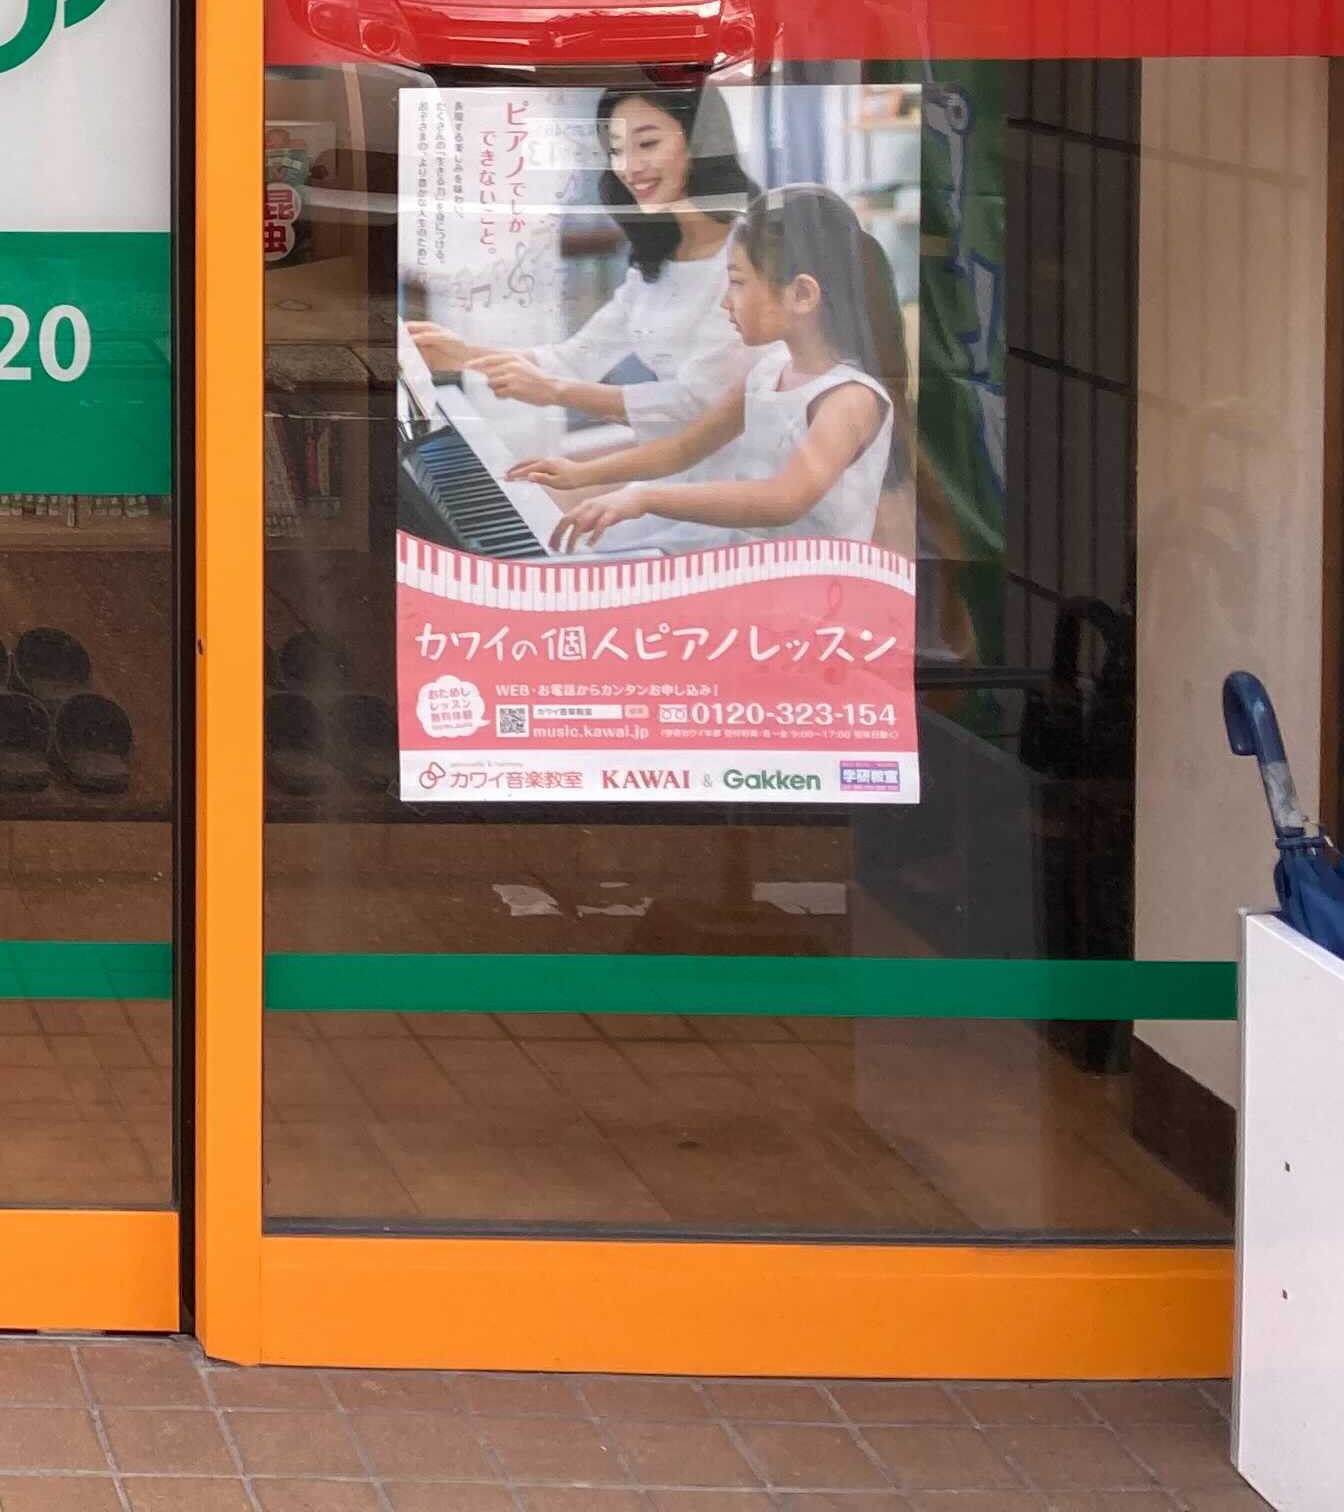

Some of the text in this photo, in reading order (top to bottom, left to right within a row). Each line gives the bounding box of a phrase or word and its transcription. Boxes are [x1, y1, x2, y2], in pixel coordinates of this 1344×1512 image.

[505, 100, 530, 233] ピアノでしか
[480, 131, 497, 255] できないこと。
[415, 622, 897, 664] カワイの個人ピアノレッスン
[692, 702, 897, 726] 0120-323-154
[533, 725, 649, 739] music.kawai.jp
[449, 771, 584, 789] カワイ音楽教室
[602, 769, 690, 789] KAWAI
[723, 768, 821, 790] Gakken
